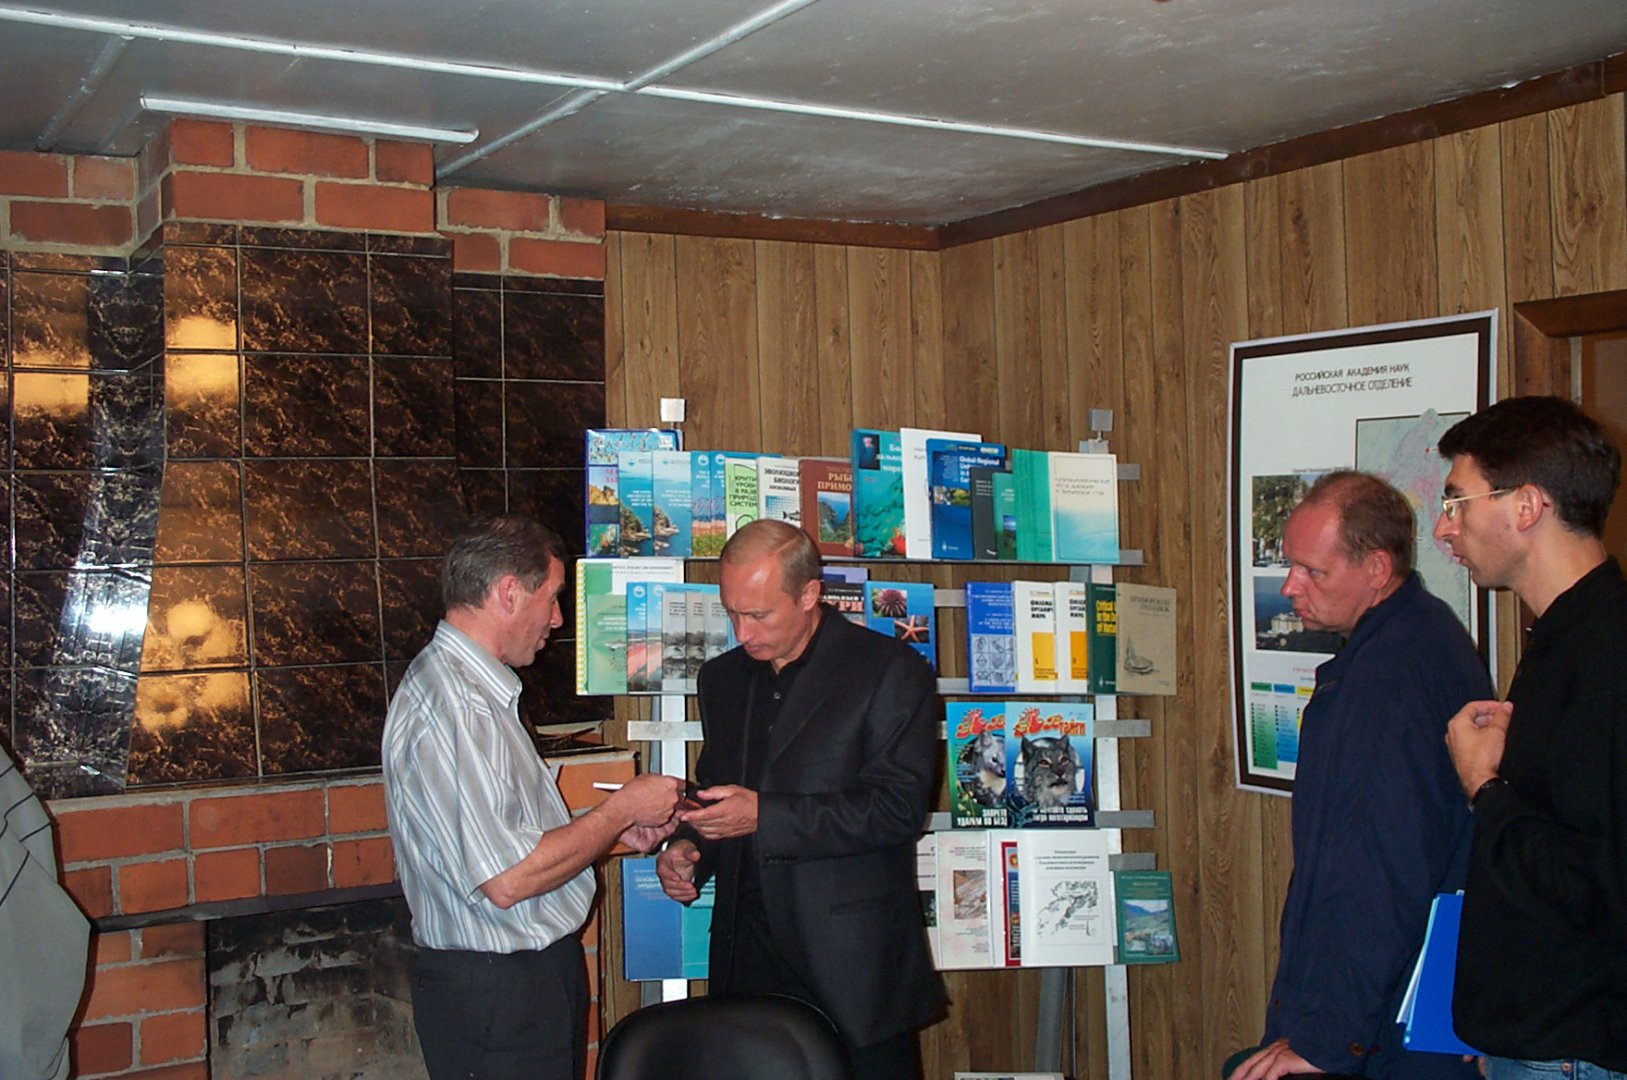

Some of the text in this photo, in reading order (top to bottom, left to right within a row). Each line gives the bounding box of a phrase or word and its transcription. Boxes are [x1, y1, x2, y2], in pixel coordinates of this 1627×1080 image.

[1295, 363, 1410, 381] РОССИЙСКАЯ АКАДЕМИЯ НАУК
[1292, 377, 1413, 397] ДАЛЬНЕВОСТОЧНОЕ ОТДЕЛЕНИЕ
[764, 468, 800, 477] ЭВОЛЮЦИО
